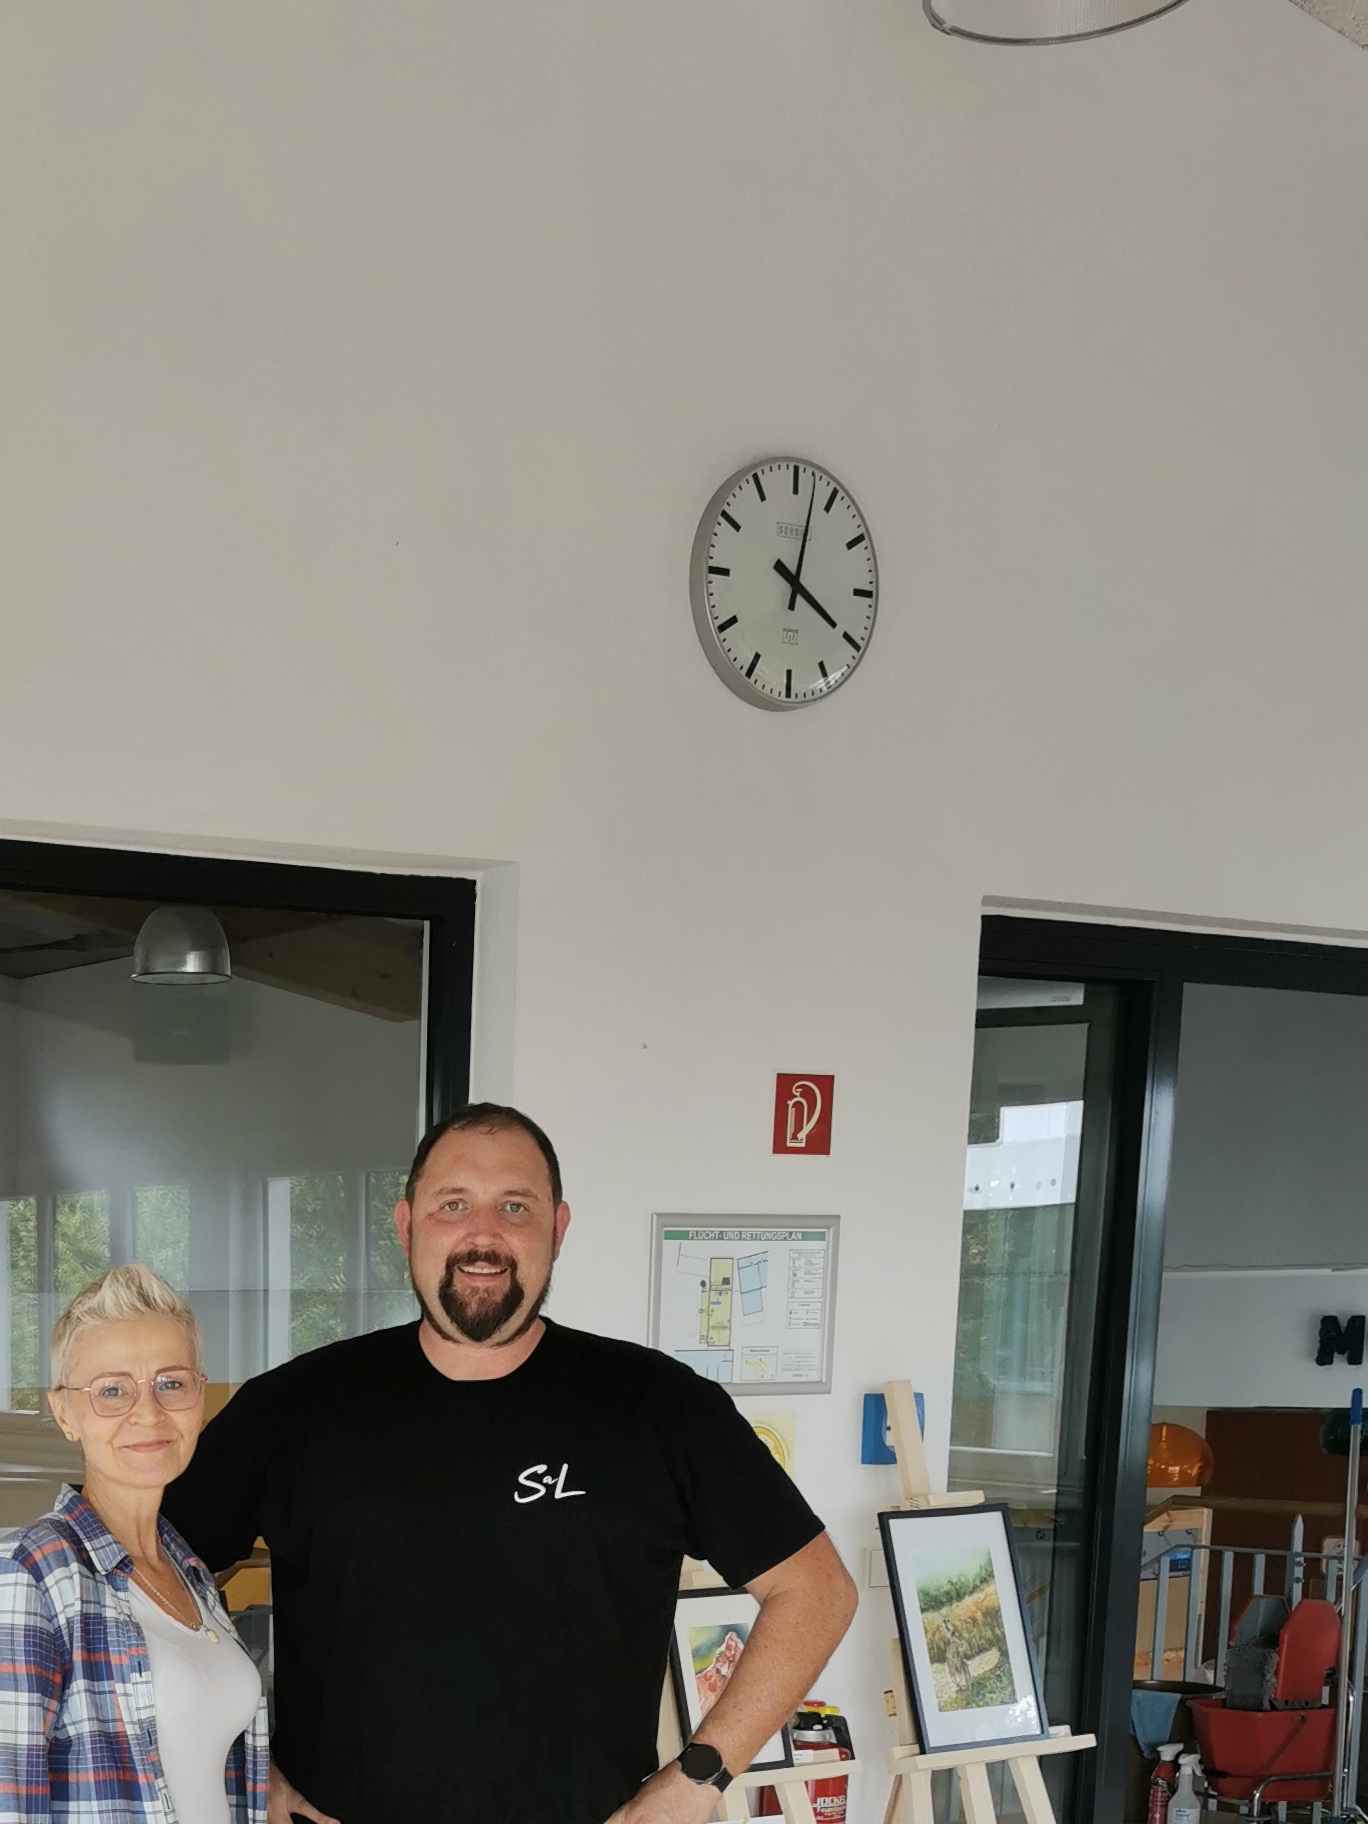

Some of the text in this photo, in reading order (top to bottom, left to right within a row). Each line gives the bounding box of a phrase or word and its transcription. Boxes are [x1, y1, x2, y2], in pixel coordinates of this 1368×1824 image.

[723, 1231, 740, 1240] UND
[741, 1231, 803, 1241] RETTUNGSPLAN
[812, 1795, 846, 1808] JOCKE
